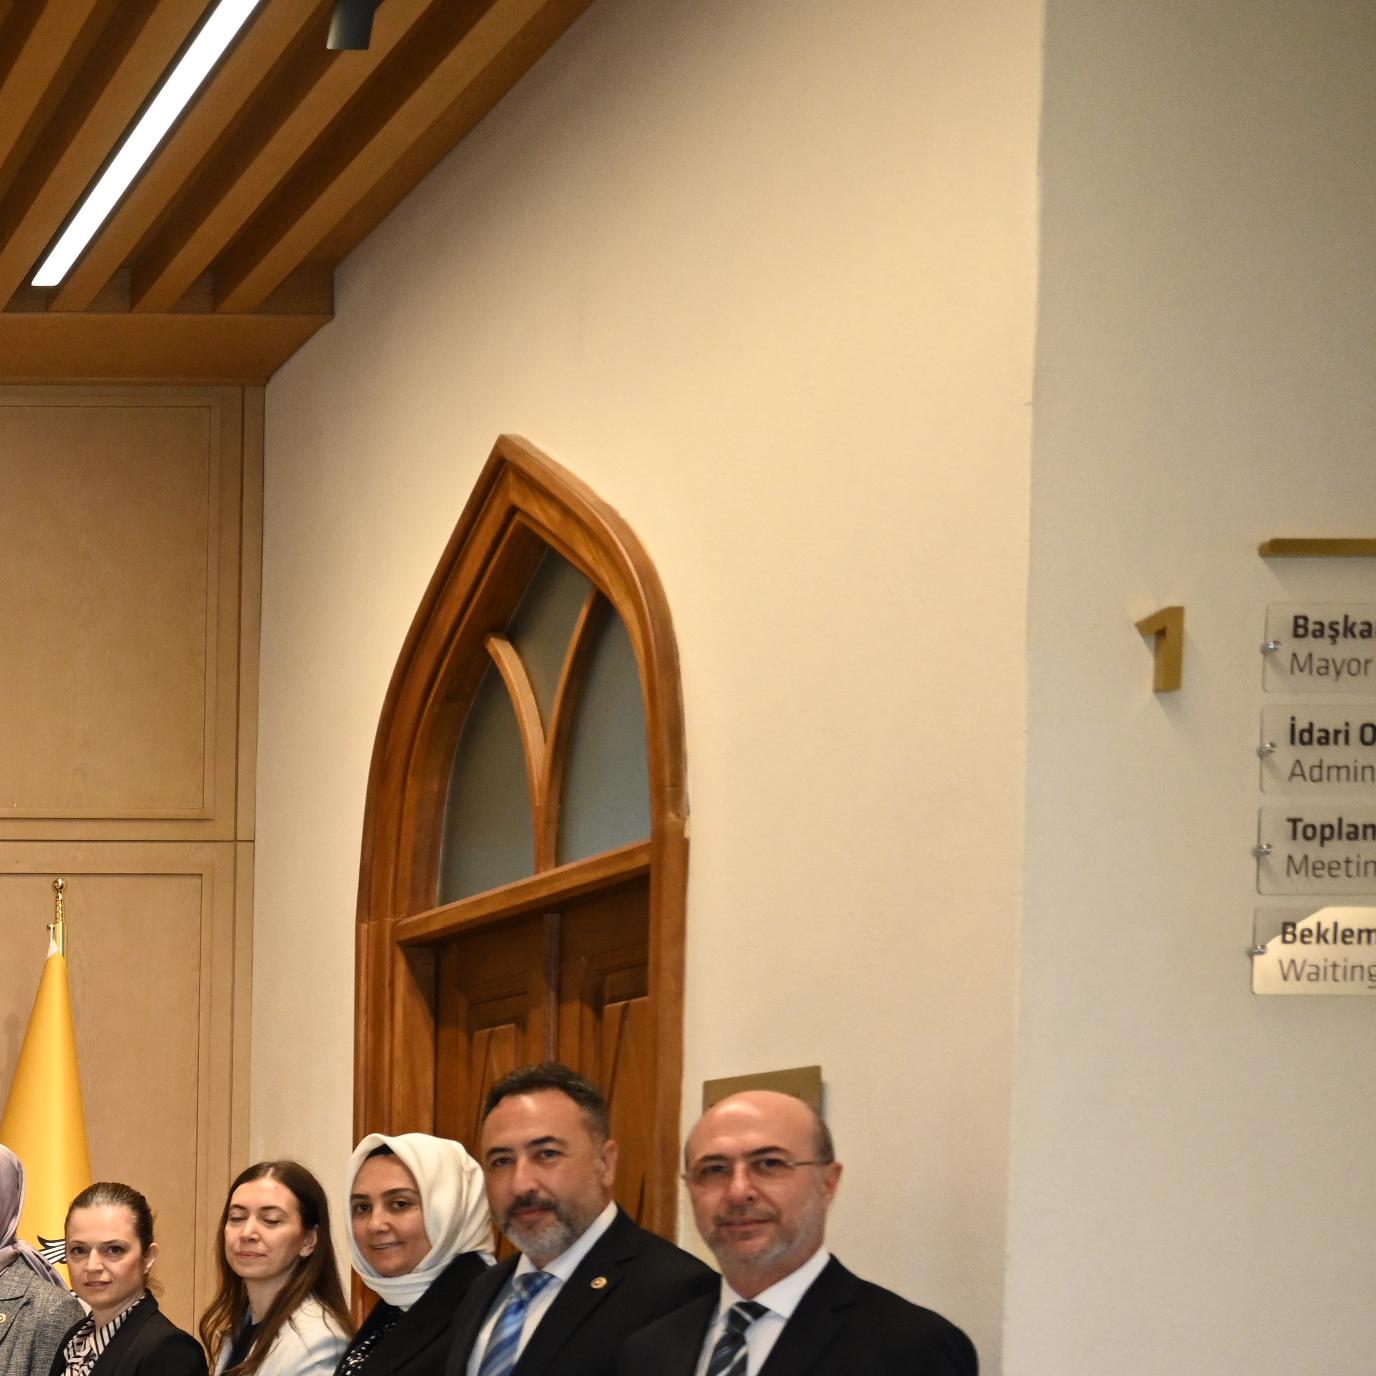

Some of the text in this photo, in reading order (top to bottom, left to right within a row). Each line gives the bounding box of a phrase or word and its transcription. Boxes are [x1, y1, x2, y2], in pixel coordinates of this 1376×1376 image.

[1292, 614, 1376, 645] Başka
[1290, 652, 1372, 682] Mayor
[1289, 716, 1350, 746] İdari
[1288, 758, 1376, 783] Admin
